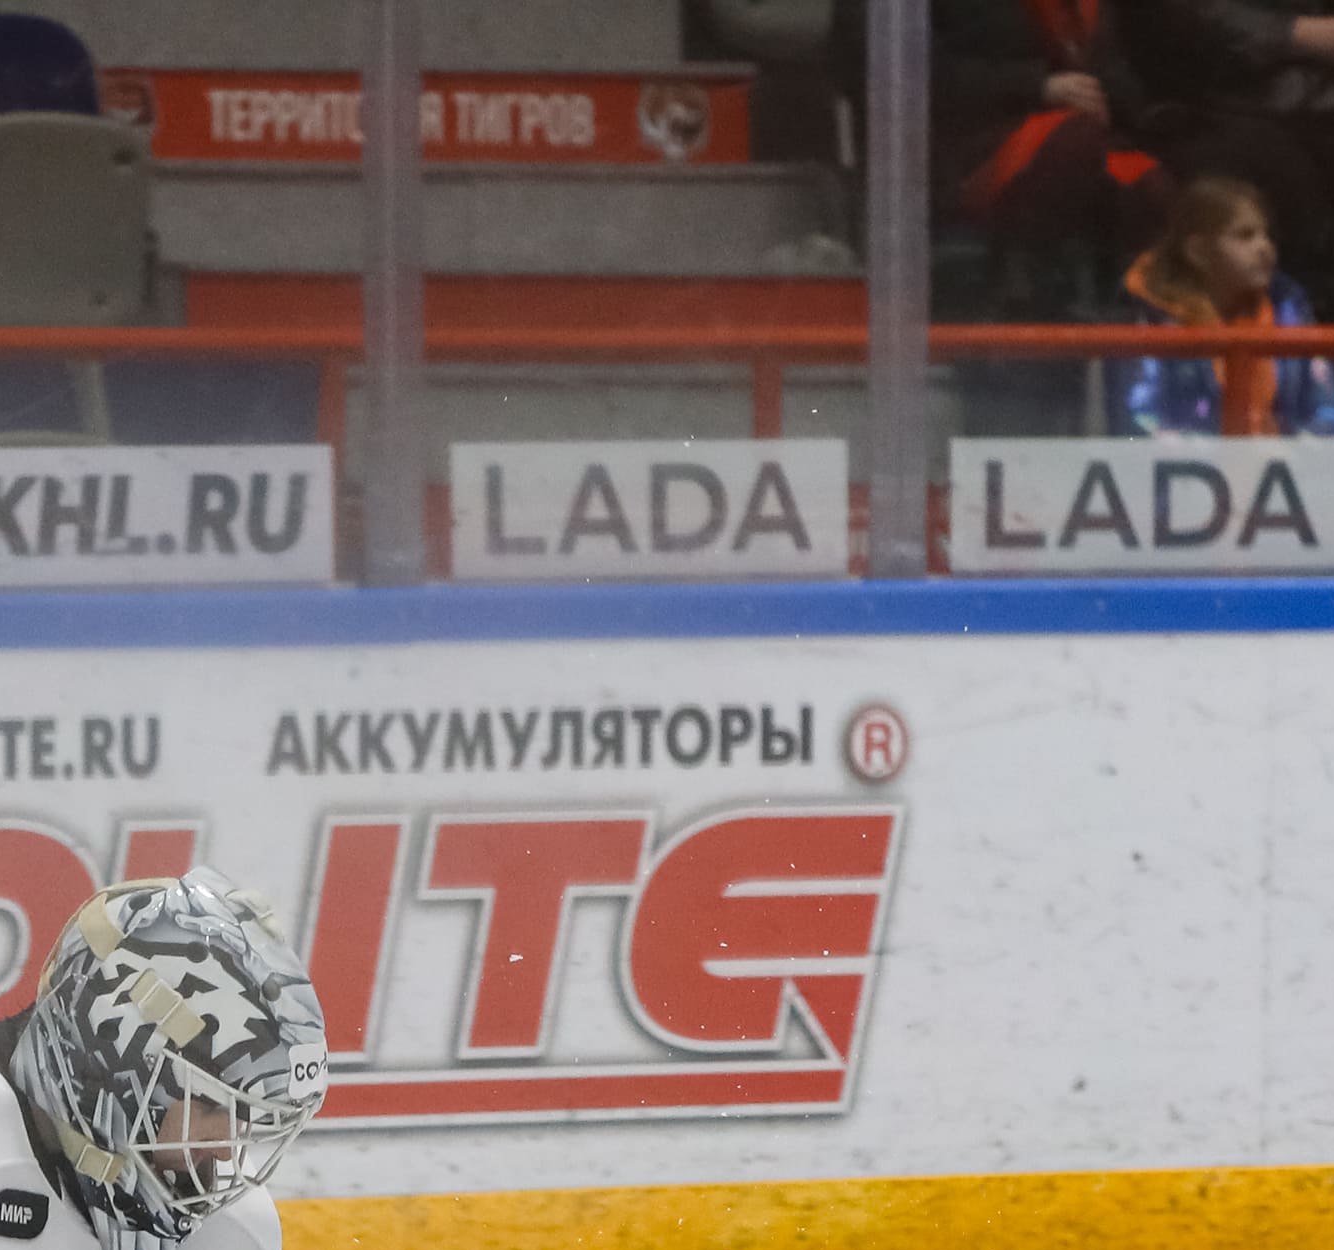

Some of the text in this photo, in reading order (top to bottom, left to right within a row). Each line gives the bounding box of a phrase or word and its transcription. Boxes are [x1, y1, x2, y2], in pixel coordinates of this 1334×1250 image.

[454, 91, 596, 145] ТИГРОВ
[483, 461, 813, 556] LADA
[984, 460, 1319, 551] LADA
[267, 704, 814, 777] АККУМУЛЯТОРЫ
[0, 1202, 34, 1226] МИР
